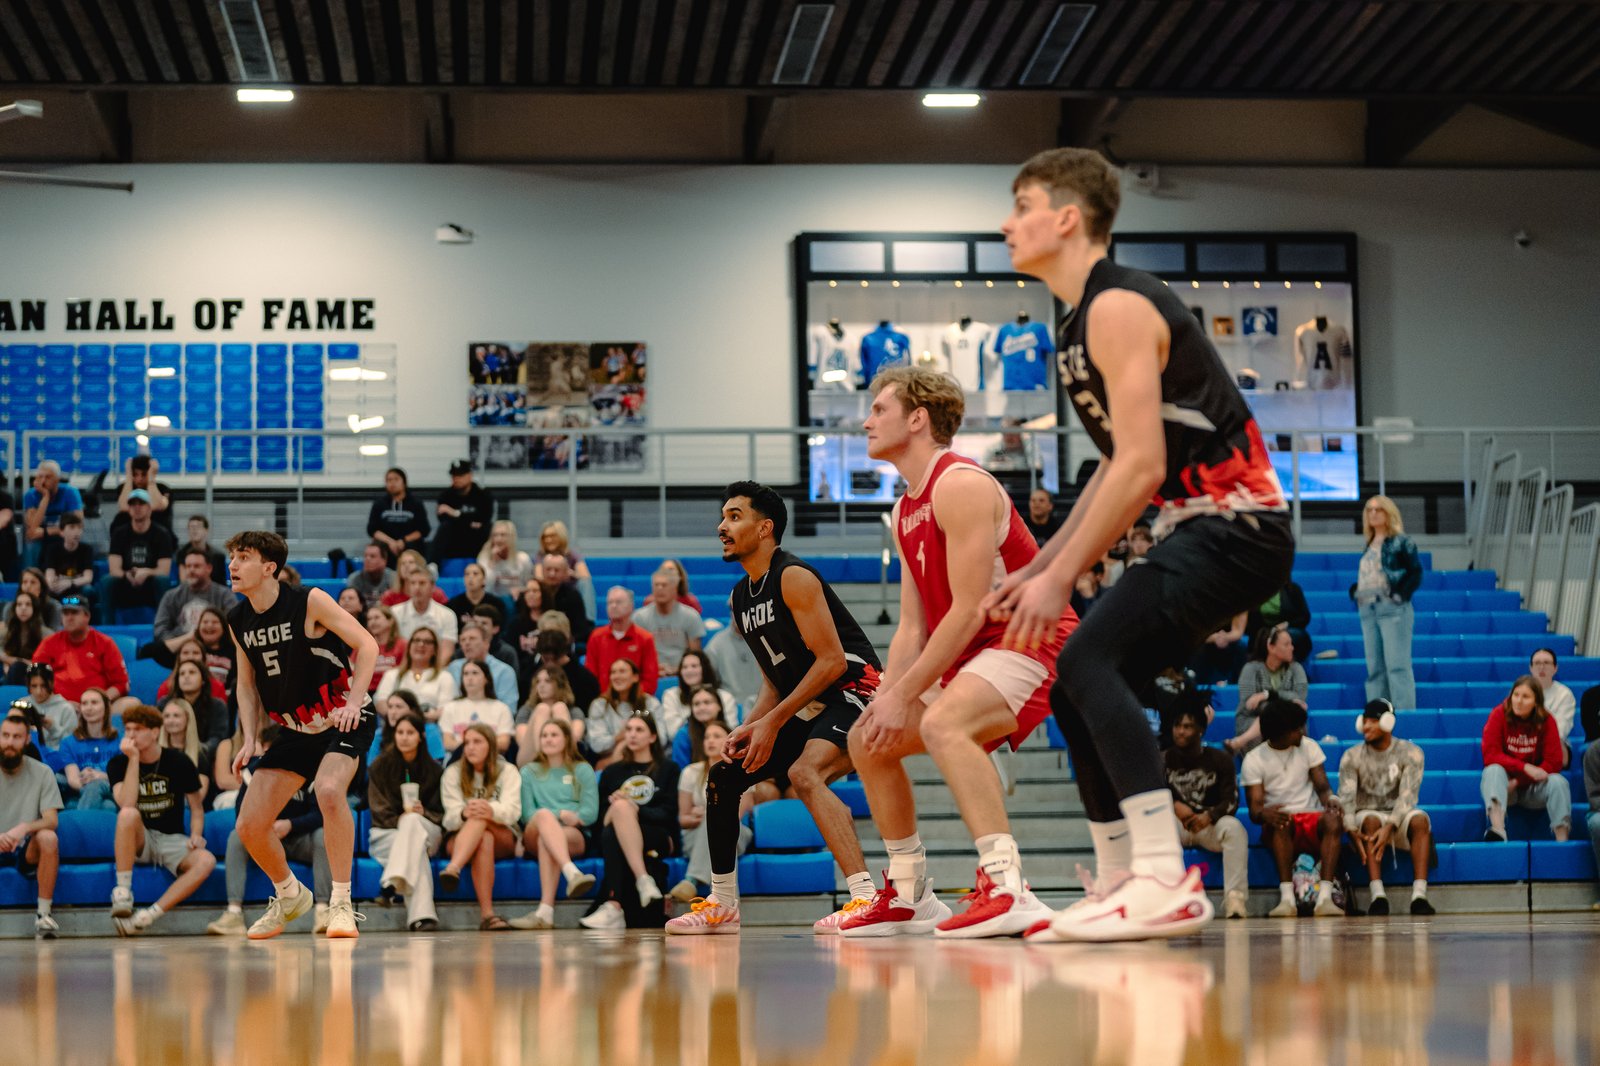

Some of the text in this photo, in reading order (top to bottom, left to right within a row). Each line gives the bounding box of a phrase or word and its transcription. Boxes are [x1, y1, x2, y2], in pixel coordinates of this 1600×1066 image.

[66, 300, 174, 331] HALL
[194, 300, 243, 330] OF
[262, 300, 374, 330] FAME
[1314, 341, 1332, 370] A
[243, 622, 293, 649] MSOE
[262, 650, 281, 677] 5
[139, 780, 167, 796] NACC
